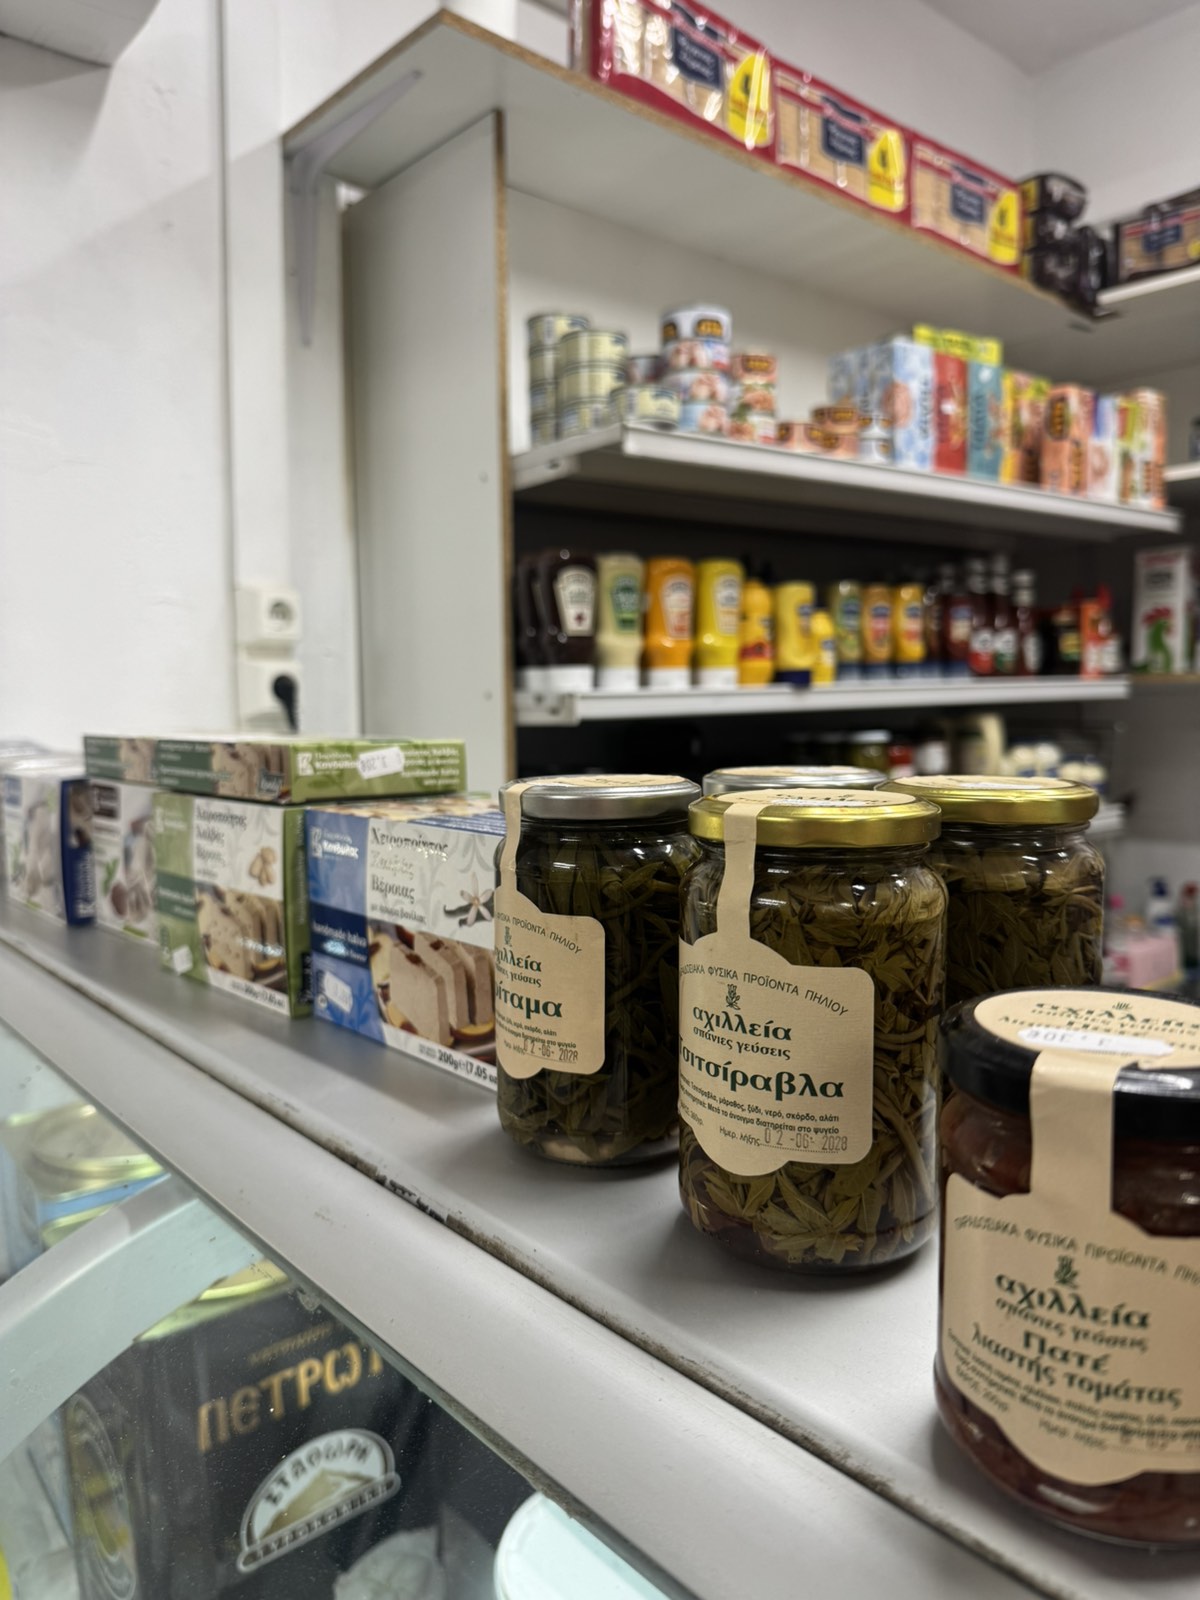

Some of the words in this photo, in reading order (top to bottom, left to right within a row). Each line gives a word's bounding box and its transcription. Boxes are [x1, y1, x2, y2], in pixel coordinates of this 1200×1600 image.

[549, 931, 583, 954] ΠΗΛΙΟΥ
[707, 966, 739, 981] ΦΥΣΙΚΑ
[743, 972, 799, 996] ΠΡΟΪΟΝΤΑ
[804, 989, 849, 1017] ΠΗΛΙΟΥ
[692, 1006, 792, 1041] αχιλλεία
[693, 1026, 733, 1050] σπάνιες
[736, 1040, 791, 1060] γεύσεις
[785, 1112, 818, 1122] σκόρδο,
[818, 1114, 840, 1122] αλάτι
[813, 1126, 840, 1135] ψυγείο
[821, 1135, 848, 1152] 2028
[1084, 1242, 1167, 1274] ΠΡΟΪΟΝΤΑ
[995, 1274, 1151, 1329] αχιλλεία
[1023, 1329, 1111, 1375] Πατέ
[1070, 1325, 1148, 1352] γεύσεις
[972, 1321, 1056, 1387] λιαστής
[1062, 1371, 1184, 1412] τομάτας
